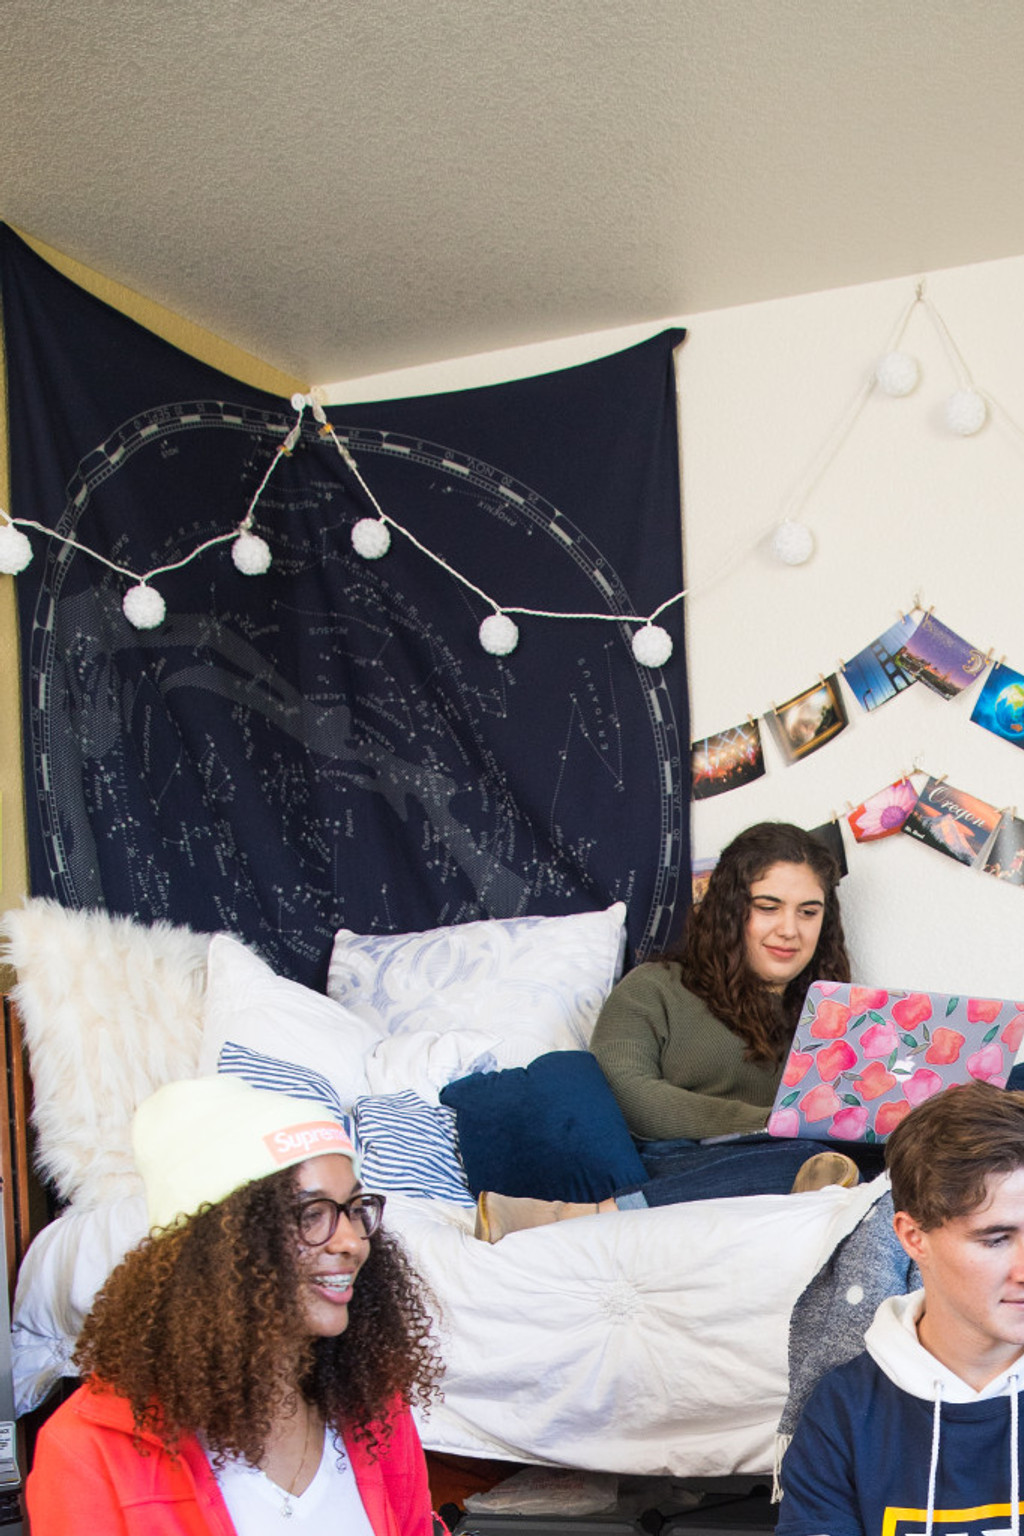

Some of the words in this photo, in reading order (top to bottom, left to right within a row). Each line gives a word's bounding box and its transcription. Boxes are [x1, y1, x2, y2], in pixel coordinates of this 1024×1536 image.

[466, 455, 495, 478] NOV.
[673, 780, 682, 813] JAN.
[928, 786, 986, 828] Oregon
